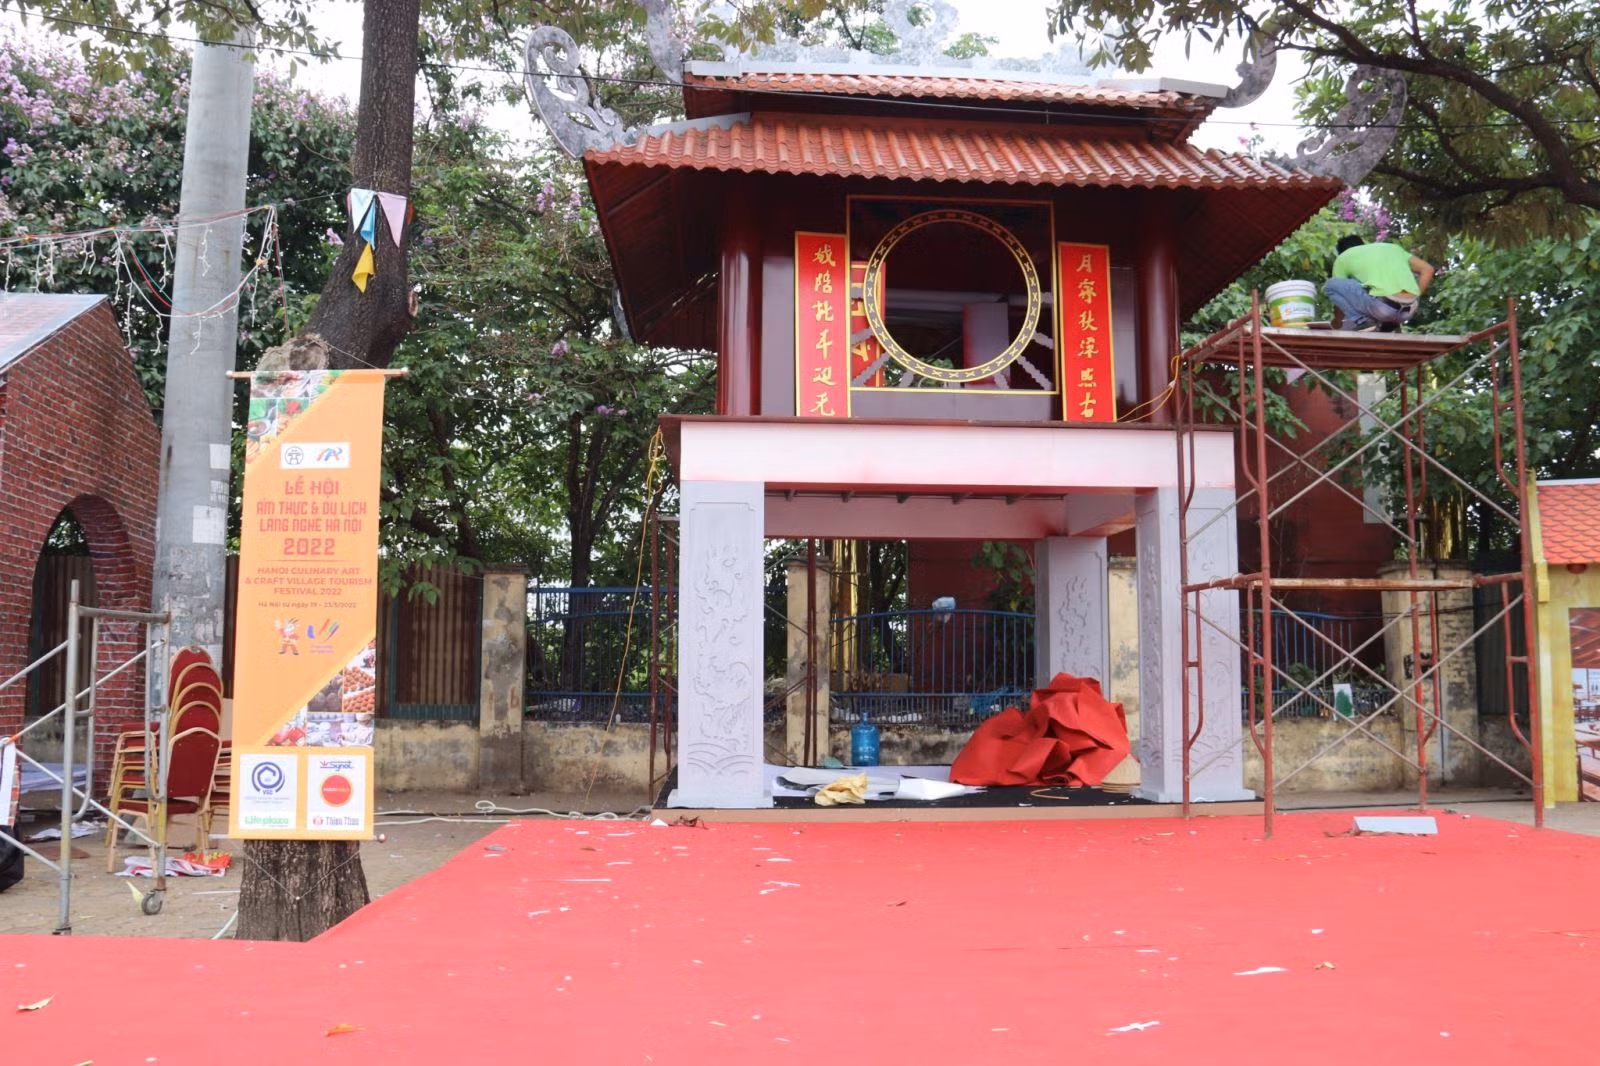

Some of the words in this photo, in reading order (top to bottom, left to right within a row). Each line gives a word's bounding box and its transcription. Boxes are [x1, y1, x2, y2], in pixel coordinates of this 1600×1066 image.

[310, 477, 339, 498] HỘI
[311, 501, 319, 515] &
[322, 501, 337, 515] DU
[284, 538, 335, 555] 2022
[257, 567, 289, 575] HANOI
[290, 567, 340, 575] CULINARY
[341, 567, 361, 575] ART
[244, 577, 252, 585] &
[253, 577, 284, 585] CRAFT
[286, 577, 327, 585] VILLAGE
[329, 577, 372, 586] TOURISM
[273, 587, 318, 595] FESTIVAL
